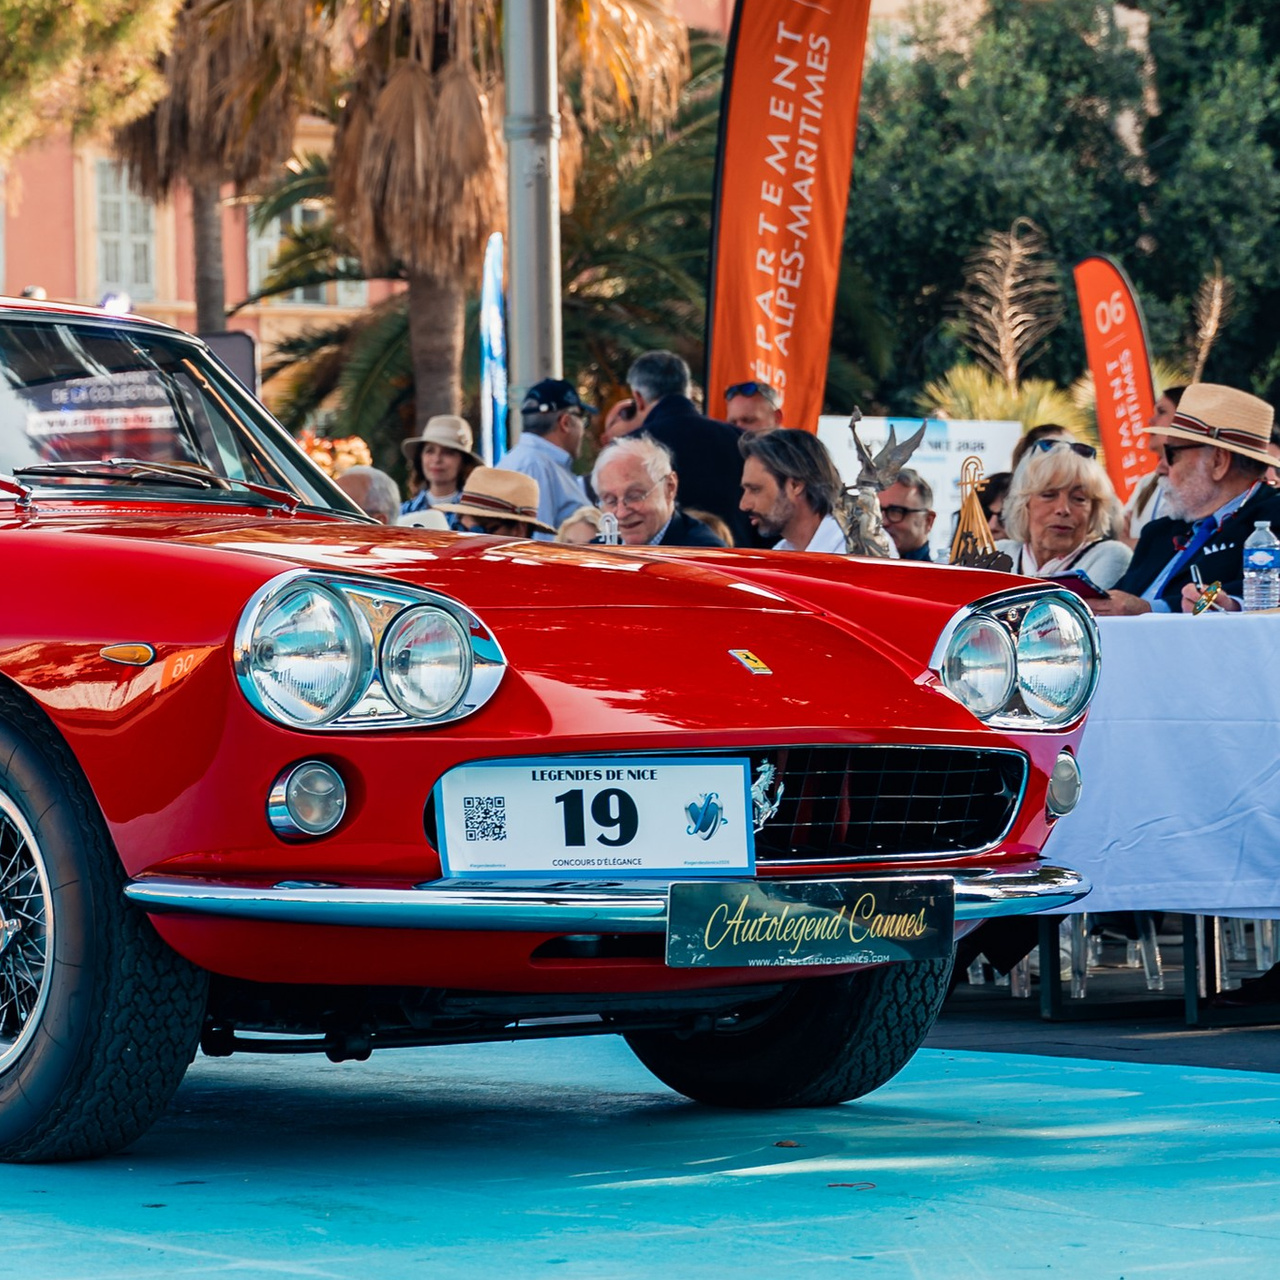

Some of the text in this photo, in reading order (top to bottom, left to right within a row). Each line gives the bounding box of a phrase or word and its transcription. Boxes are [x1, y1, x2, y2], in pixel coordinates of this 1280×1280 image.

[750, 21, 803, 384] ÉPARTEMENT
[774, 33, 830, 356] ALPES-MARITIMES
[1095, 290, 1126, 334] 06
[532, 769, 658, 781] LEGENDES DE NICE
[555, 788, 639, 846] 19
[597, 857, 642, 866] D'ÉLÉGANCE
[704, 893, 927, 955] Autolegend Cannes
